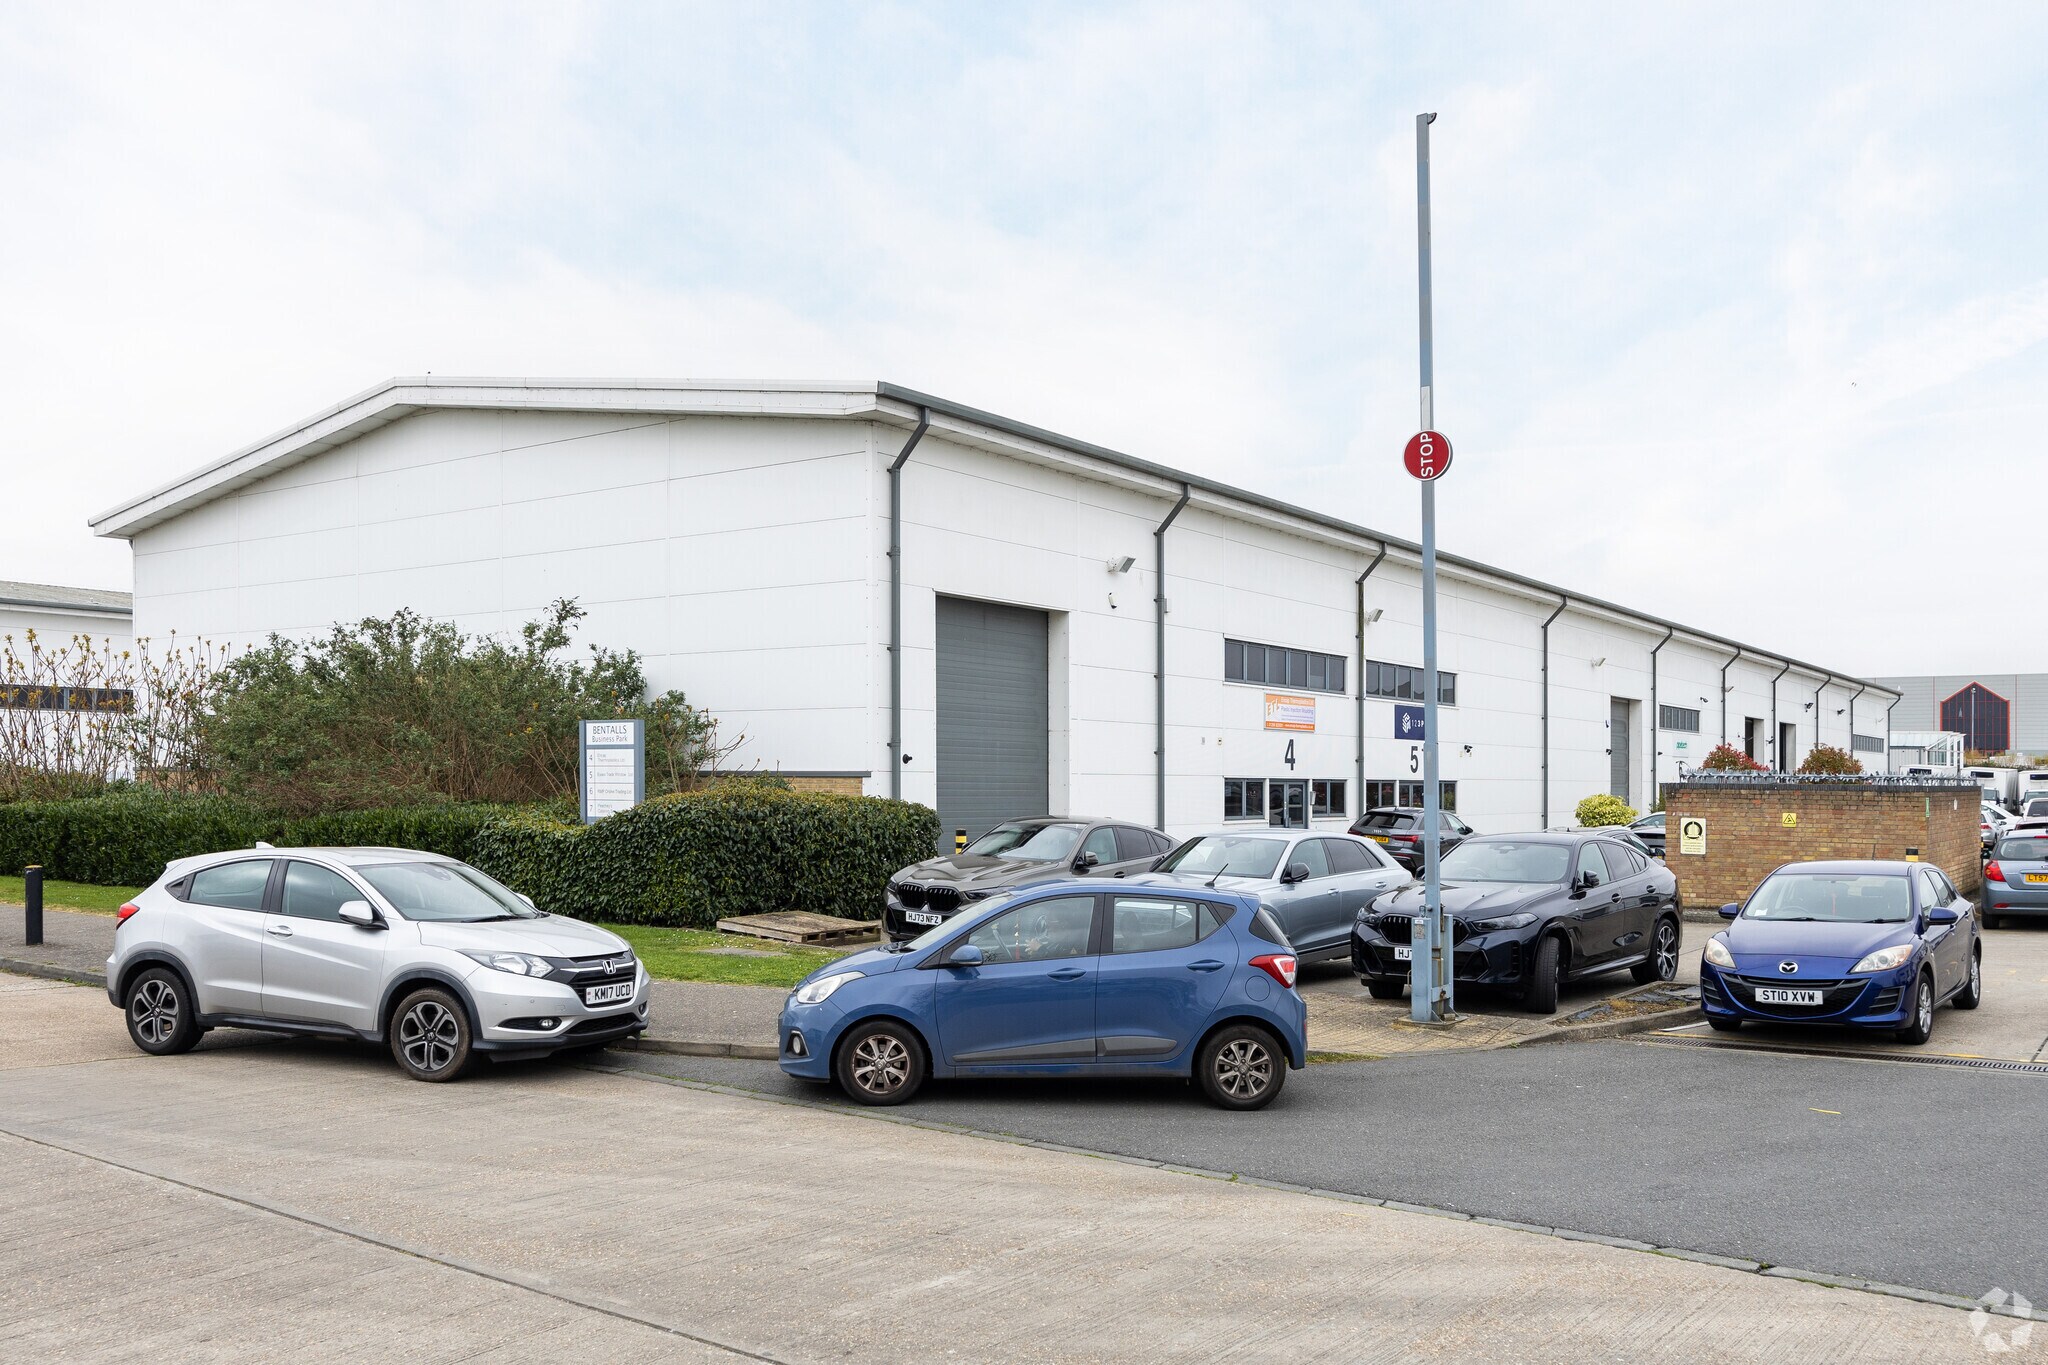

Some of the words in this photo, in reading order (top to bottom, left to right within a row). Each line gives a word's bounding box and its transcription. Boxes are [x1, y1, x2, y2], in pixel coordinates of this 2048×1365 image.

[1420, 433, 1433, 477] STOP
[1267, 698, 1279, 716] ETL
[592, 725, 628, 735] BENTALLS
[592, 735, 615, 743] Business
[1285, 739, 1295, 770] 4
[1410, 746, 1418, 773] 5
[589, 771, 593, 779] 5
[589, 787, 593, 795] 6
[589, 804, 593, 812] 7
[2028, 874, 2048, 882] LT57
[908, 912, 925, 922] HJ73
[925, 914, 939, 924] NFZ
[594, 986, 614, 1001] KM17
[615, 984, 631, 998] UCD
[1762, 989, 1788, 1001] ST10
[1791, 991, 1815, 1003] XVW
